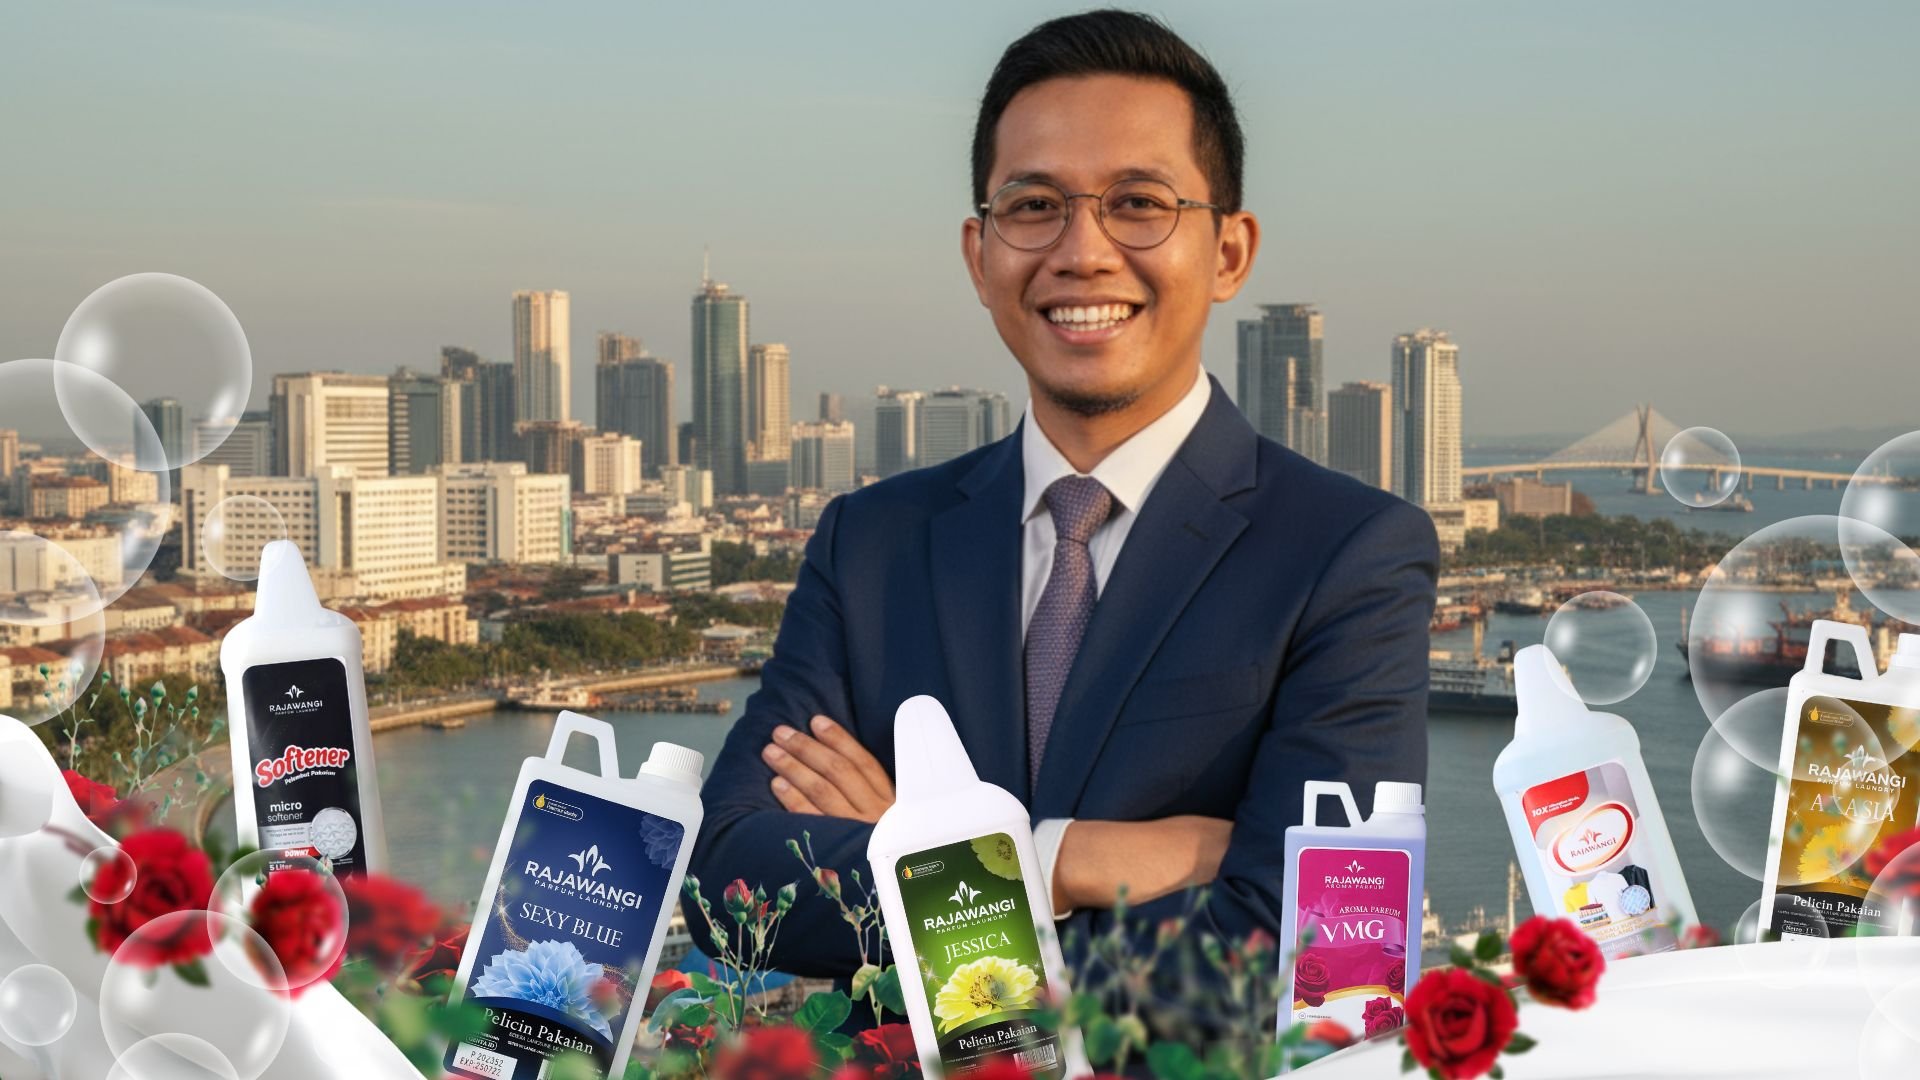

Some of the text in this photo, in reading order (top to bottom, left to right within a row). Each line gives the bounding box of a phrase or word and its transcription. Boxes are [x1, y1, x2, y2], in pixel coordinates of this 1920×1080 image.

[269, 700, 323, 712] RAJAWANGI
[255, 744, 351, 788] Softener
[1808, 763, 1907, 789] RAJAWANGI
[1855, 783, 1895, 793] LAUNDRY
[267, 812, 304, 822] softener
[270, 801, 303, 812] micro
[1532, 806, 1548, 817] 10X
[1809, 793, 1895, 822] AASIA
[1570, 837, 1617, 857] RAJAWANGI
[525, 860, 643, 909] RAJAWANGI
[1324, 876, 1385, 885] RAJAWANGI
[534, 879, 626, 912] PARFUM LAUNDRY
[1792, 895, 1833, 911] Pelicin
[1837, 901, 1881, 917] Pakaian
[923, 898, 1016, 931] RAJAWANGI
[936, 913, 1008, 935] PARFUM LAUNDRY
[1339, 905, 1401, 918] AROMA PARFUM
[519, 902, 624, 948] SEXY BLUE
[1320, 919, 1386, 944] VMG
[944, 931, 1012, 964] JESSICA
[484, 1007, 533, 1036] Pelicin
[536, 1025, 593, 1055] Pakaian
[958, 1033, 995, 1050] Pelicin
[997, 1025, 1037, 1041] Pakaian
